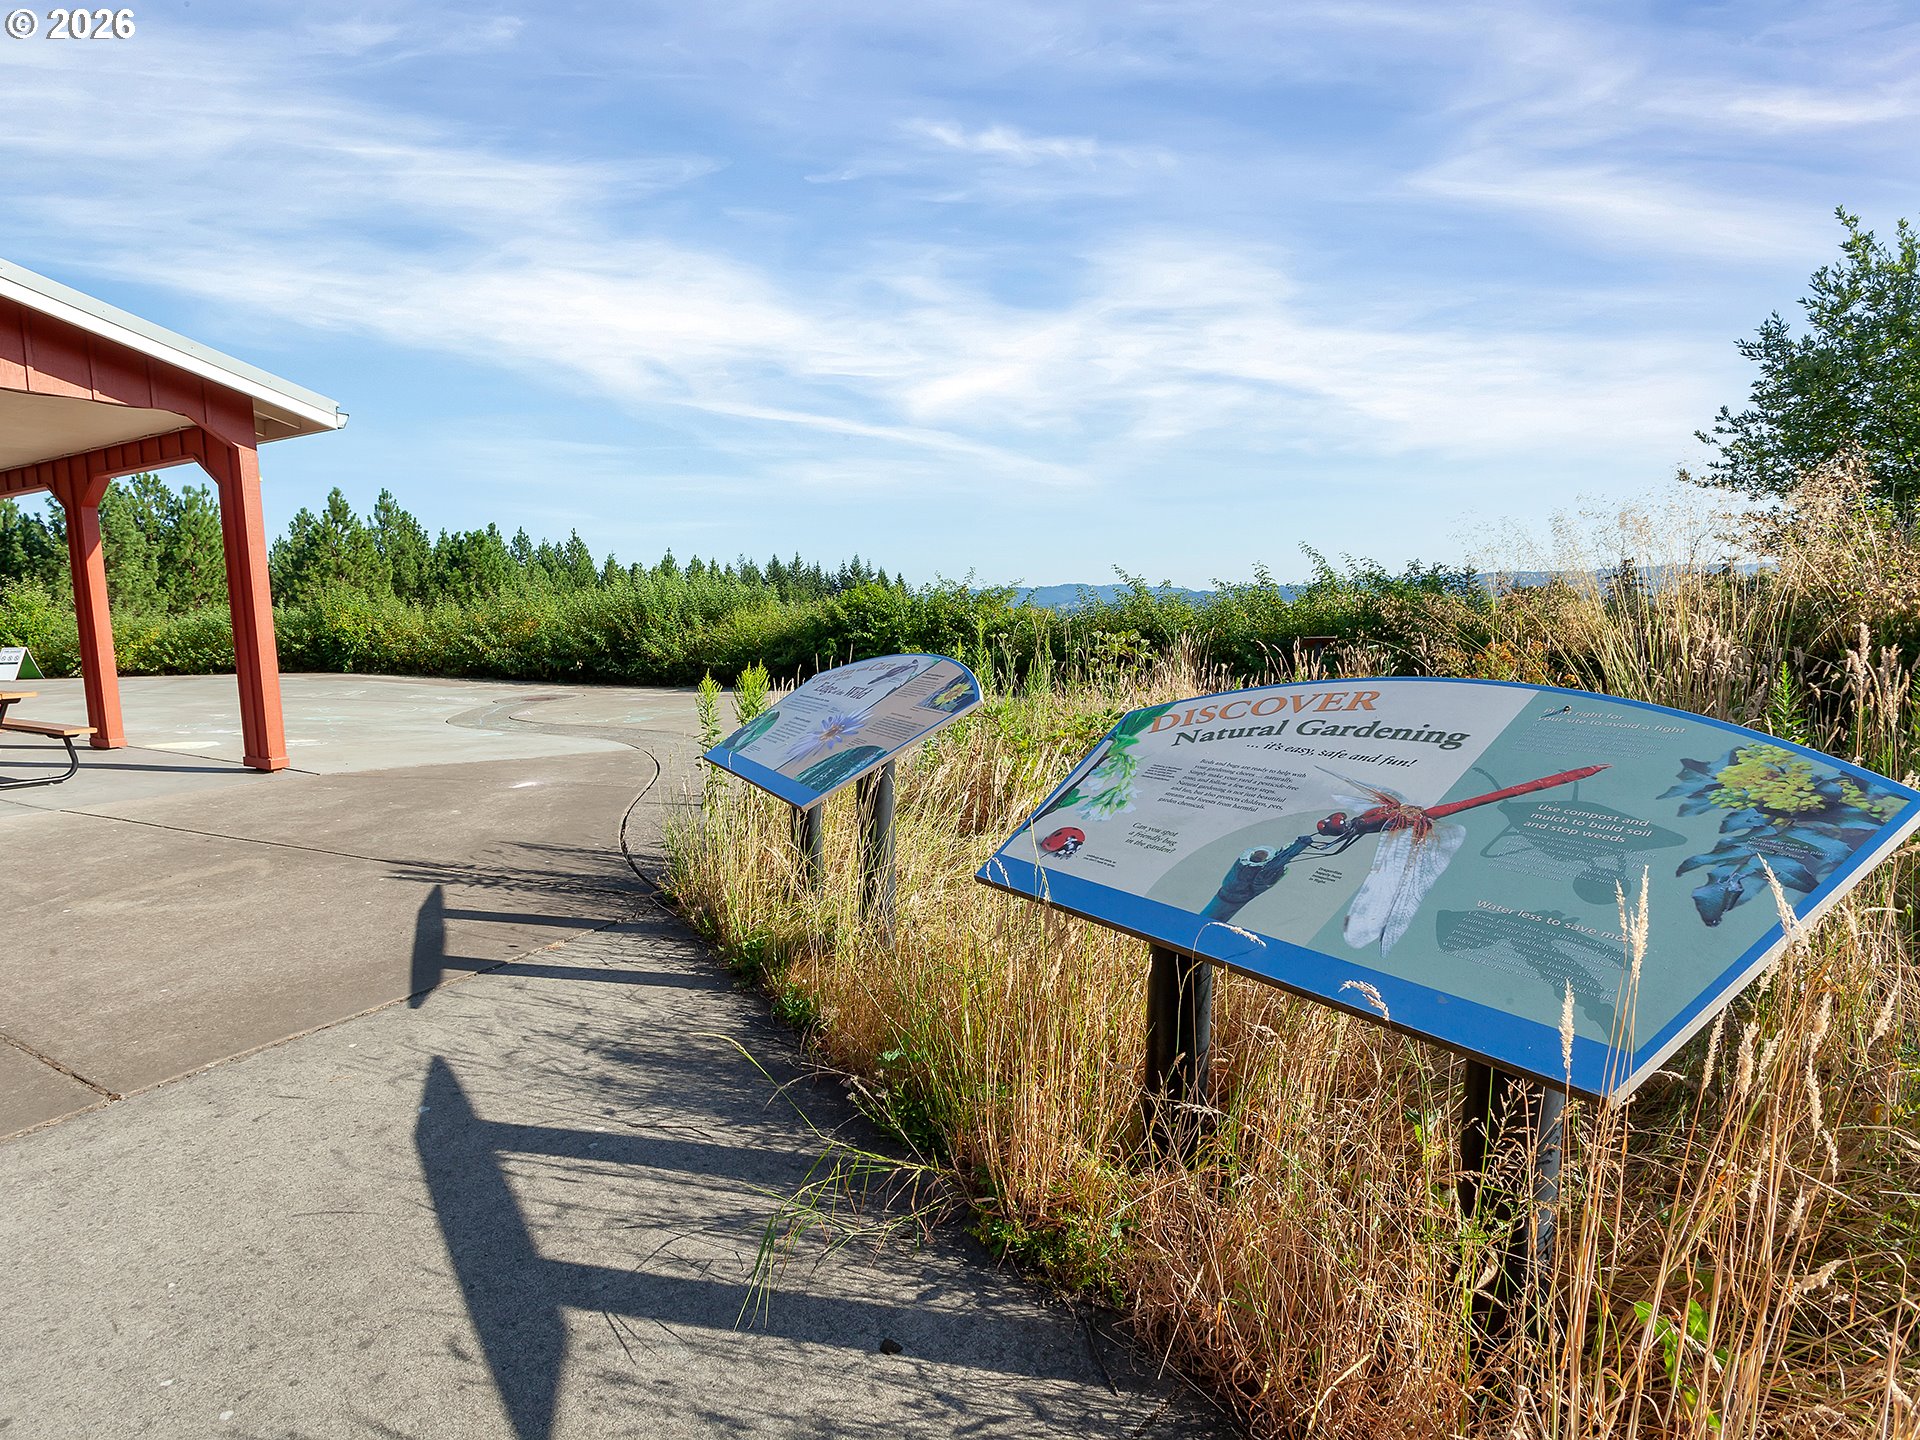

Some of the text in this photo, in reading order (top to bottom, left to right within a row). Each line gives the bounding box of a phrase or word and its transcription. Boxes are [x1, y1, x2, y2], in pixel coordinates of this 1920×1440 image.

[814, 681, 874, 700] Edge Wild
[1147, 690, 1381, 734] DISCOVER
[1574, 711, 1603, 719] right
[1606, 712, 1625, 720] for
[1171, 719, 1471, 750] Natural Gardening
[1603, 721, 1641, 729] avoid
[1653, 724, 1687, 734] fight
[1263, 741, 1284, 751] it's
[1284, 746, 1316, 757] easy,
[1318, 749, 1348, 760] safe
[1348, 752, 1384, 764] and
[1378, 755, 1418, 768] fun!
[1530, 811, 1653, 838] mulch to build soil
[1537, 803, 1651, 828] Use compost and
[1522, 820, 1626, 843] and stop weeds
[1476, 899, 1515, 915] Water
[1518, 909, 1543, 922] less
[1546, 917, 1561, 926] to
[1563, 922, 1597, 935] save
